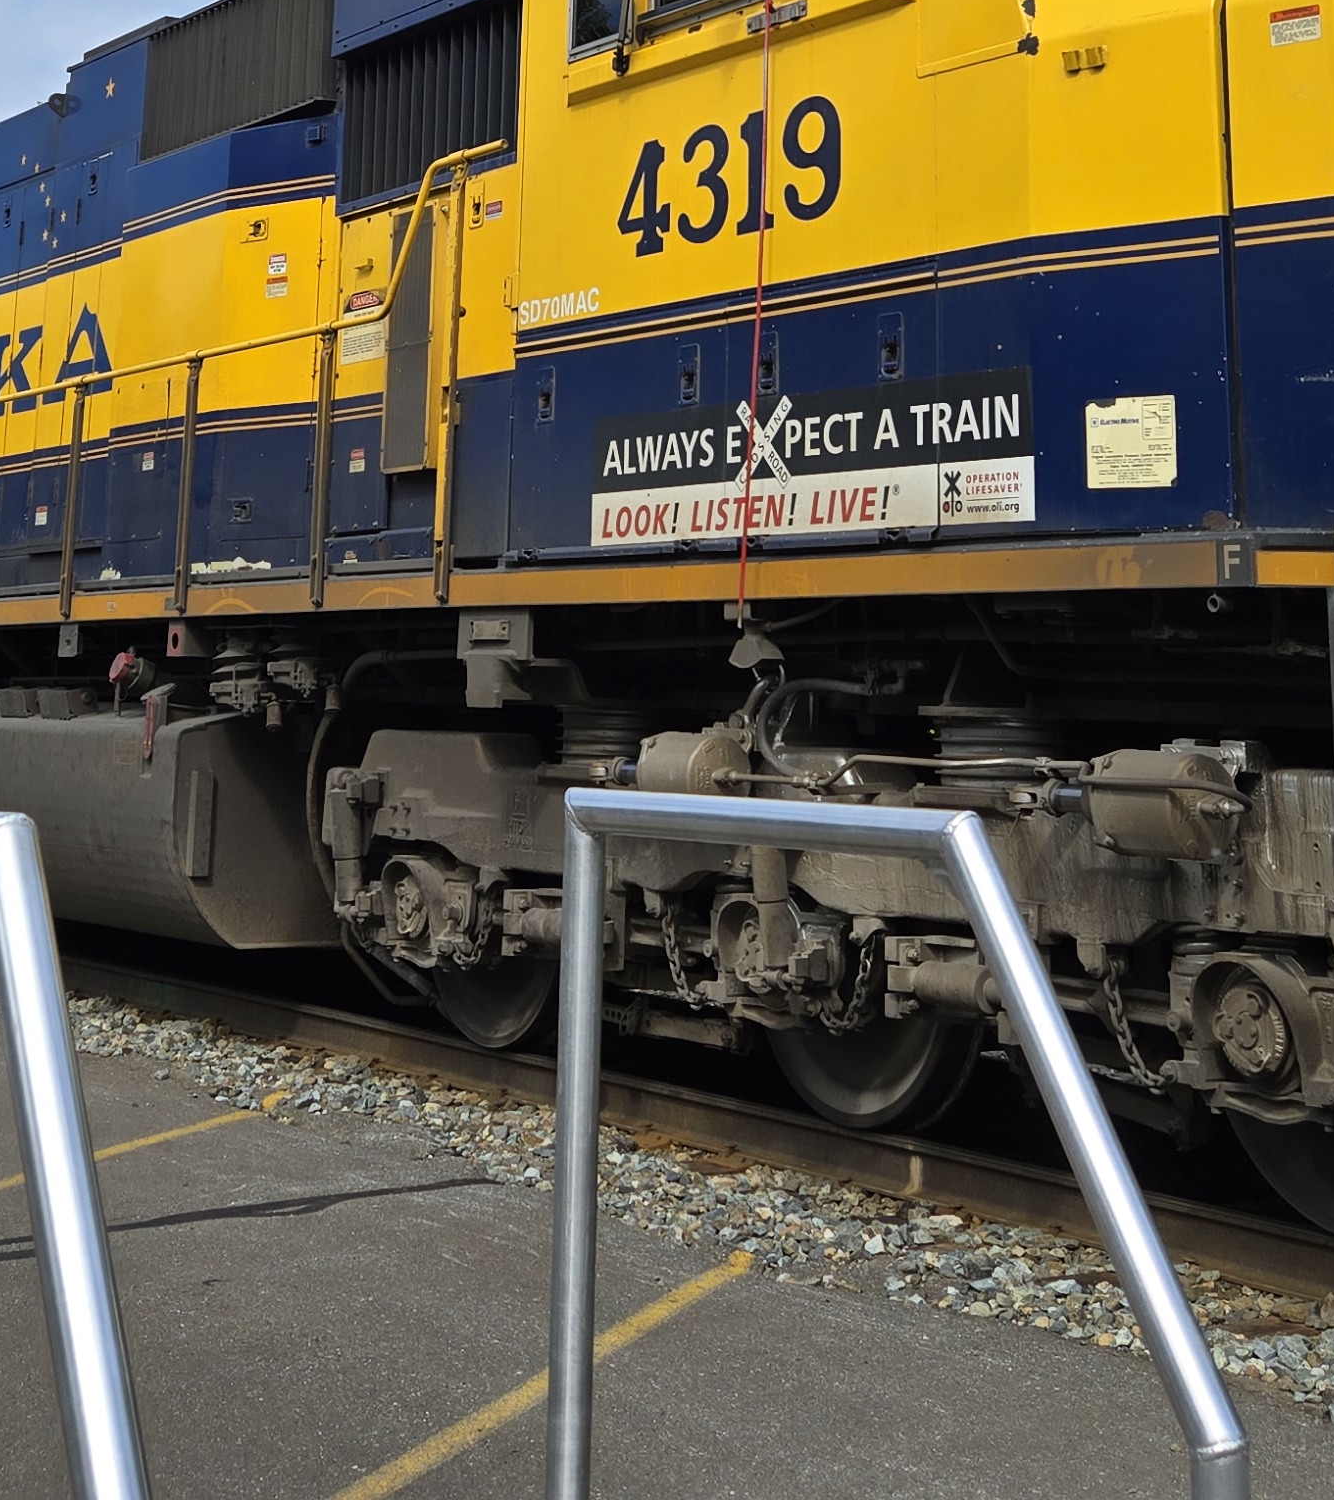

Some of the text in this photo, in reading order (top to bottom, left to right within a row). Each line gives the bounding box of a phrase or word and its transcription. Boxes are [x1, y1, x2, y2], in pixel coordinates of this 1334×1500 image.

[617, 94, 842, 258] 4319
[519, 286, 601, 326] SD70MAC
[603, 427, 714, 477] ALWAYS
[874, 407, 899, 450] A
[910, 393, 1021, 447] TRAIN
[768, 451, 788, 483] ROAD
[966, 471, 1019, 484] OPERATION
[602, 501, 679, 539] LOOK!
[690, 491, 796, 533] LISTEN!
[967, 501, 1020, 513] www.oli.org
[1223, 544, 1241, 579] F
